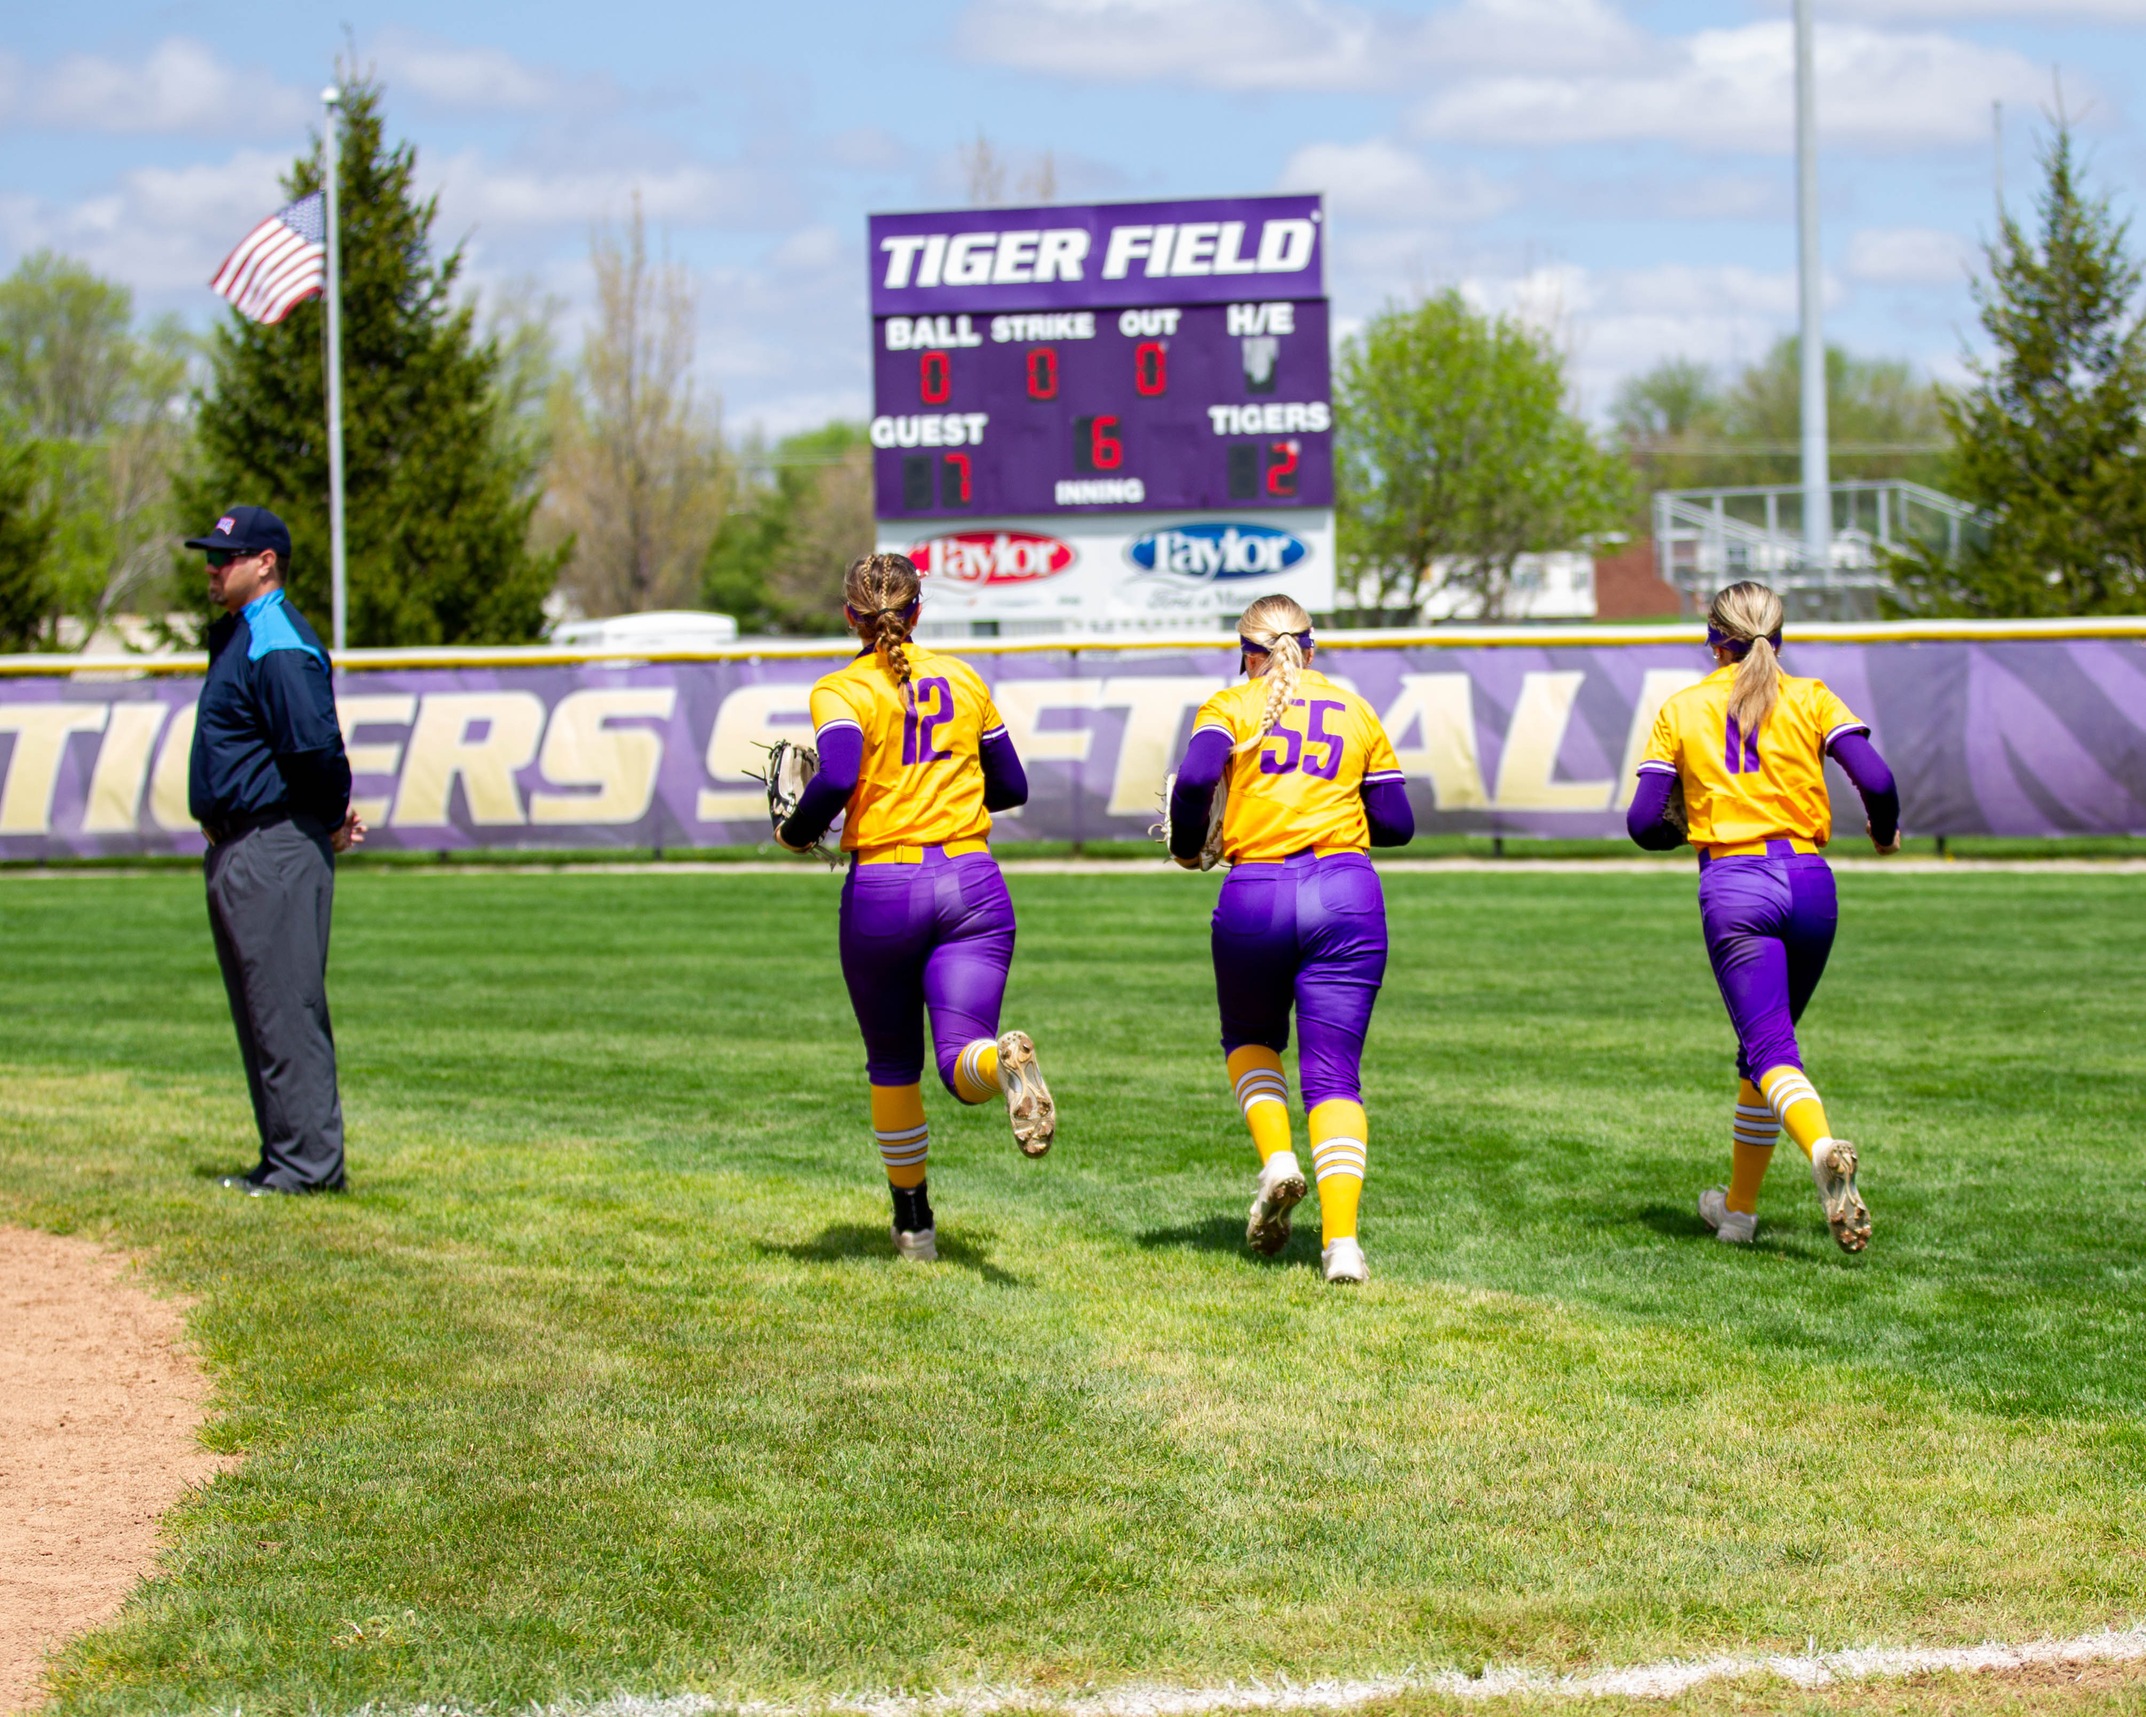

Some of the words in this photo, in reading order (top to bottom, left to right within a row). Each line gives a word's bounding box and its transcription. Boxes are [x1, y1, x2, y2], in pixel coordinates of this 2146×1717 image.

[880, 228, 1090, 290] TIGER
[1101, 218, 1317, 280] FIELD
[885, 314, 982, 350] BALL
[990, 311, 1096, 343] STRIKE
[1118, 308, 1182, 338] OUT
[1226, 301, 1295, 336] H/E
[920, 350, 951, 406] 0
[1026, 346, 1058, 401] 0
[1135, 341, 1167, 397] 0
[869, 411, 989, 449] GUEST
[1090, 414, 1123, 471] 6
[1207, 401, 1331, 435] TIGERS
[943, 451, 972, 504] 7
[1054, 477, 1145, 506] INNING
[1266, 441, 1299, 497] 2
[913, 533, 1057, 586] Taylor
[1134, 527, 1292, 585] Taylor
[901, 676, 955, 766] 12
[1259, 698, 1346, 782] 55
